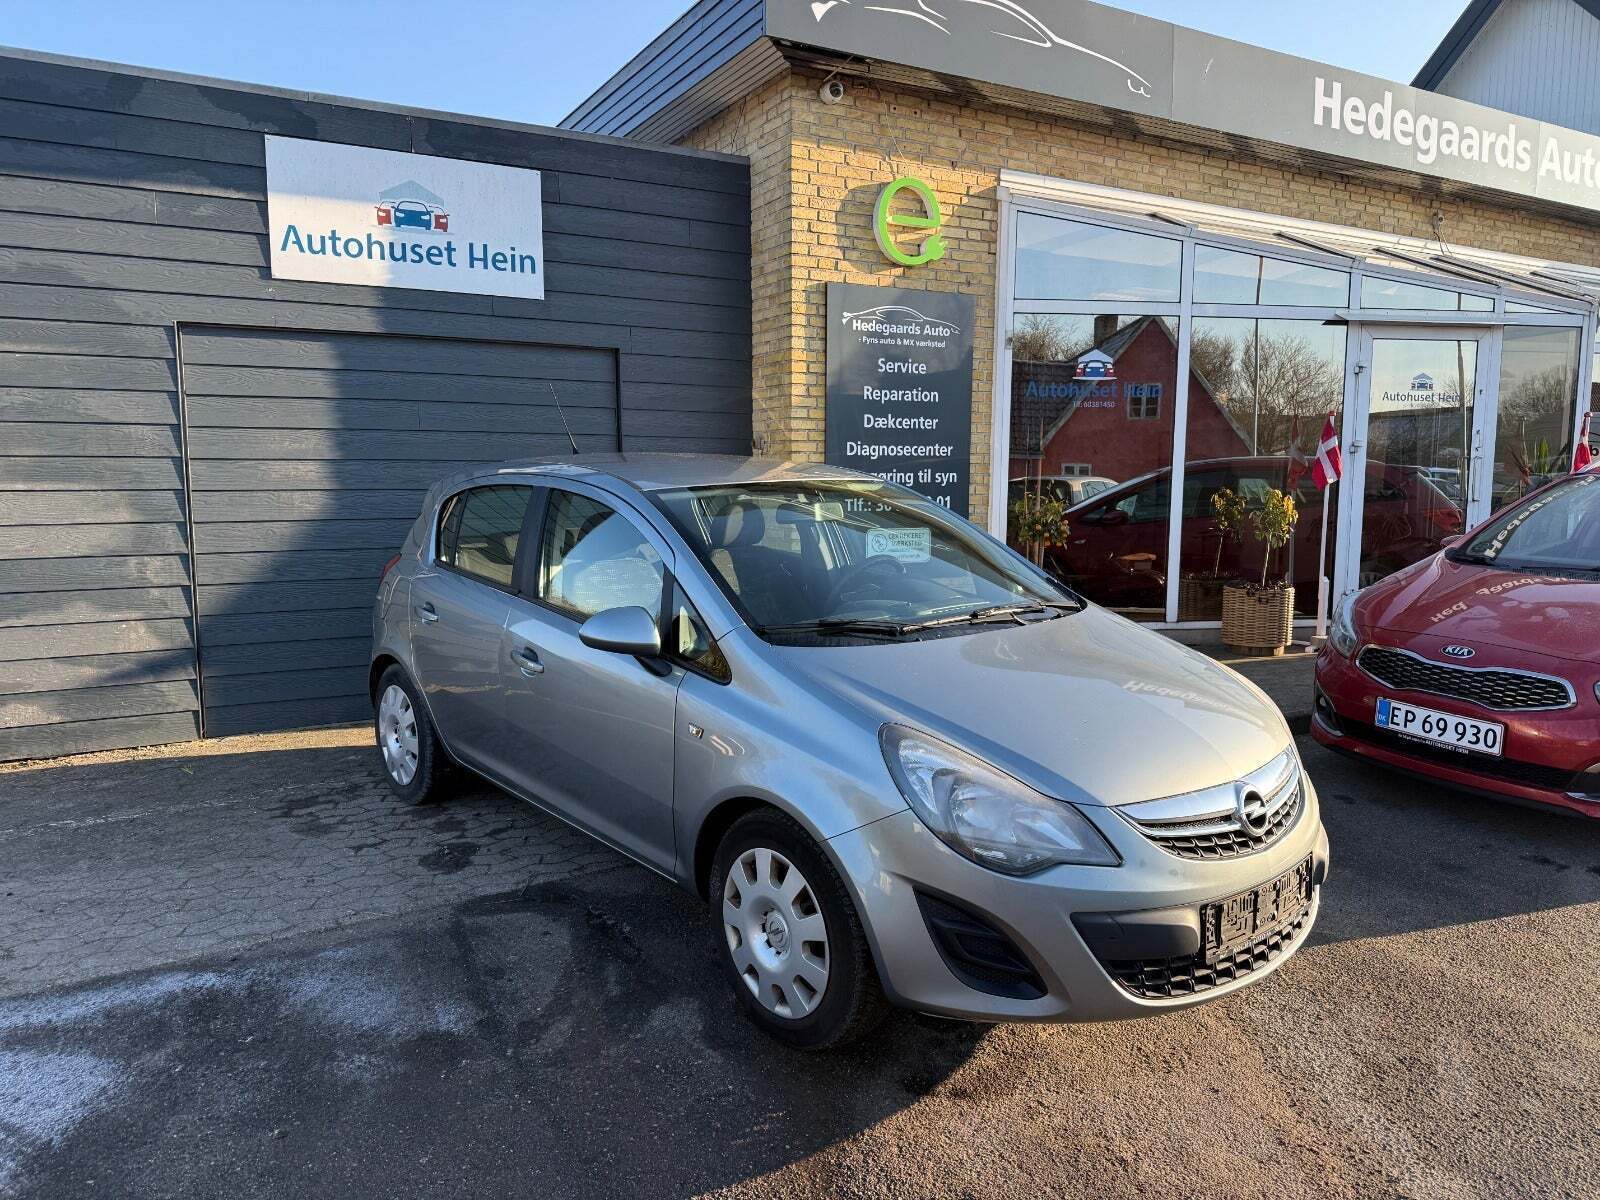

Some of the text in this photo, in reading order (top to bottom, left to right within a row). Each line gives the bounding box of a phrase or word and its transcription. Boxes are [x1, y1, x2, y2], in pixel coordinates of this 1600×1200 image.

[1313, 76, 1531, 172] Hedegaards
[280, 224, 536, 274] Autohuset Hein
[852, 320, 951, 337] Hedegaards Auto
[862, 336, 879, 345] Fyns
[915, 340, 946, 348] værksted
[877, 358, 927, 374] Service
[863, 386, 939, 404] Reparation
[1026, 380, 1118, 398] Autohuset
[1382, 391, 1434, 402] Autohuset
[863, 414, 939, 429] Dækcenter
[846, 441, 954, 459] Diagnosecenter
[918, 469, 931, 483] til
[935, 472, 957, 487] syn
[1445, 645, 1469, 656] KIA
[1390, 706, 1417, 729] EP
[1421, 714, 1448, 738] 69
[1454, 721, 1498, 749] 930
